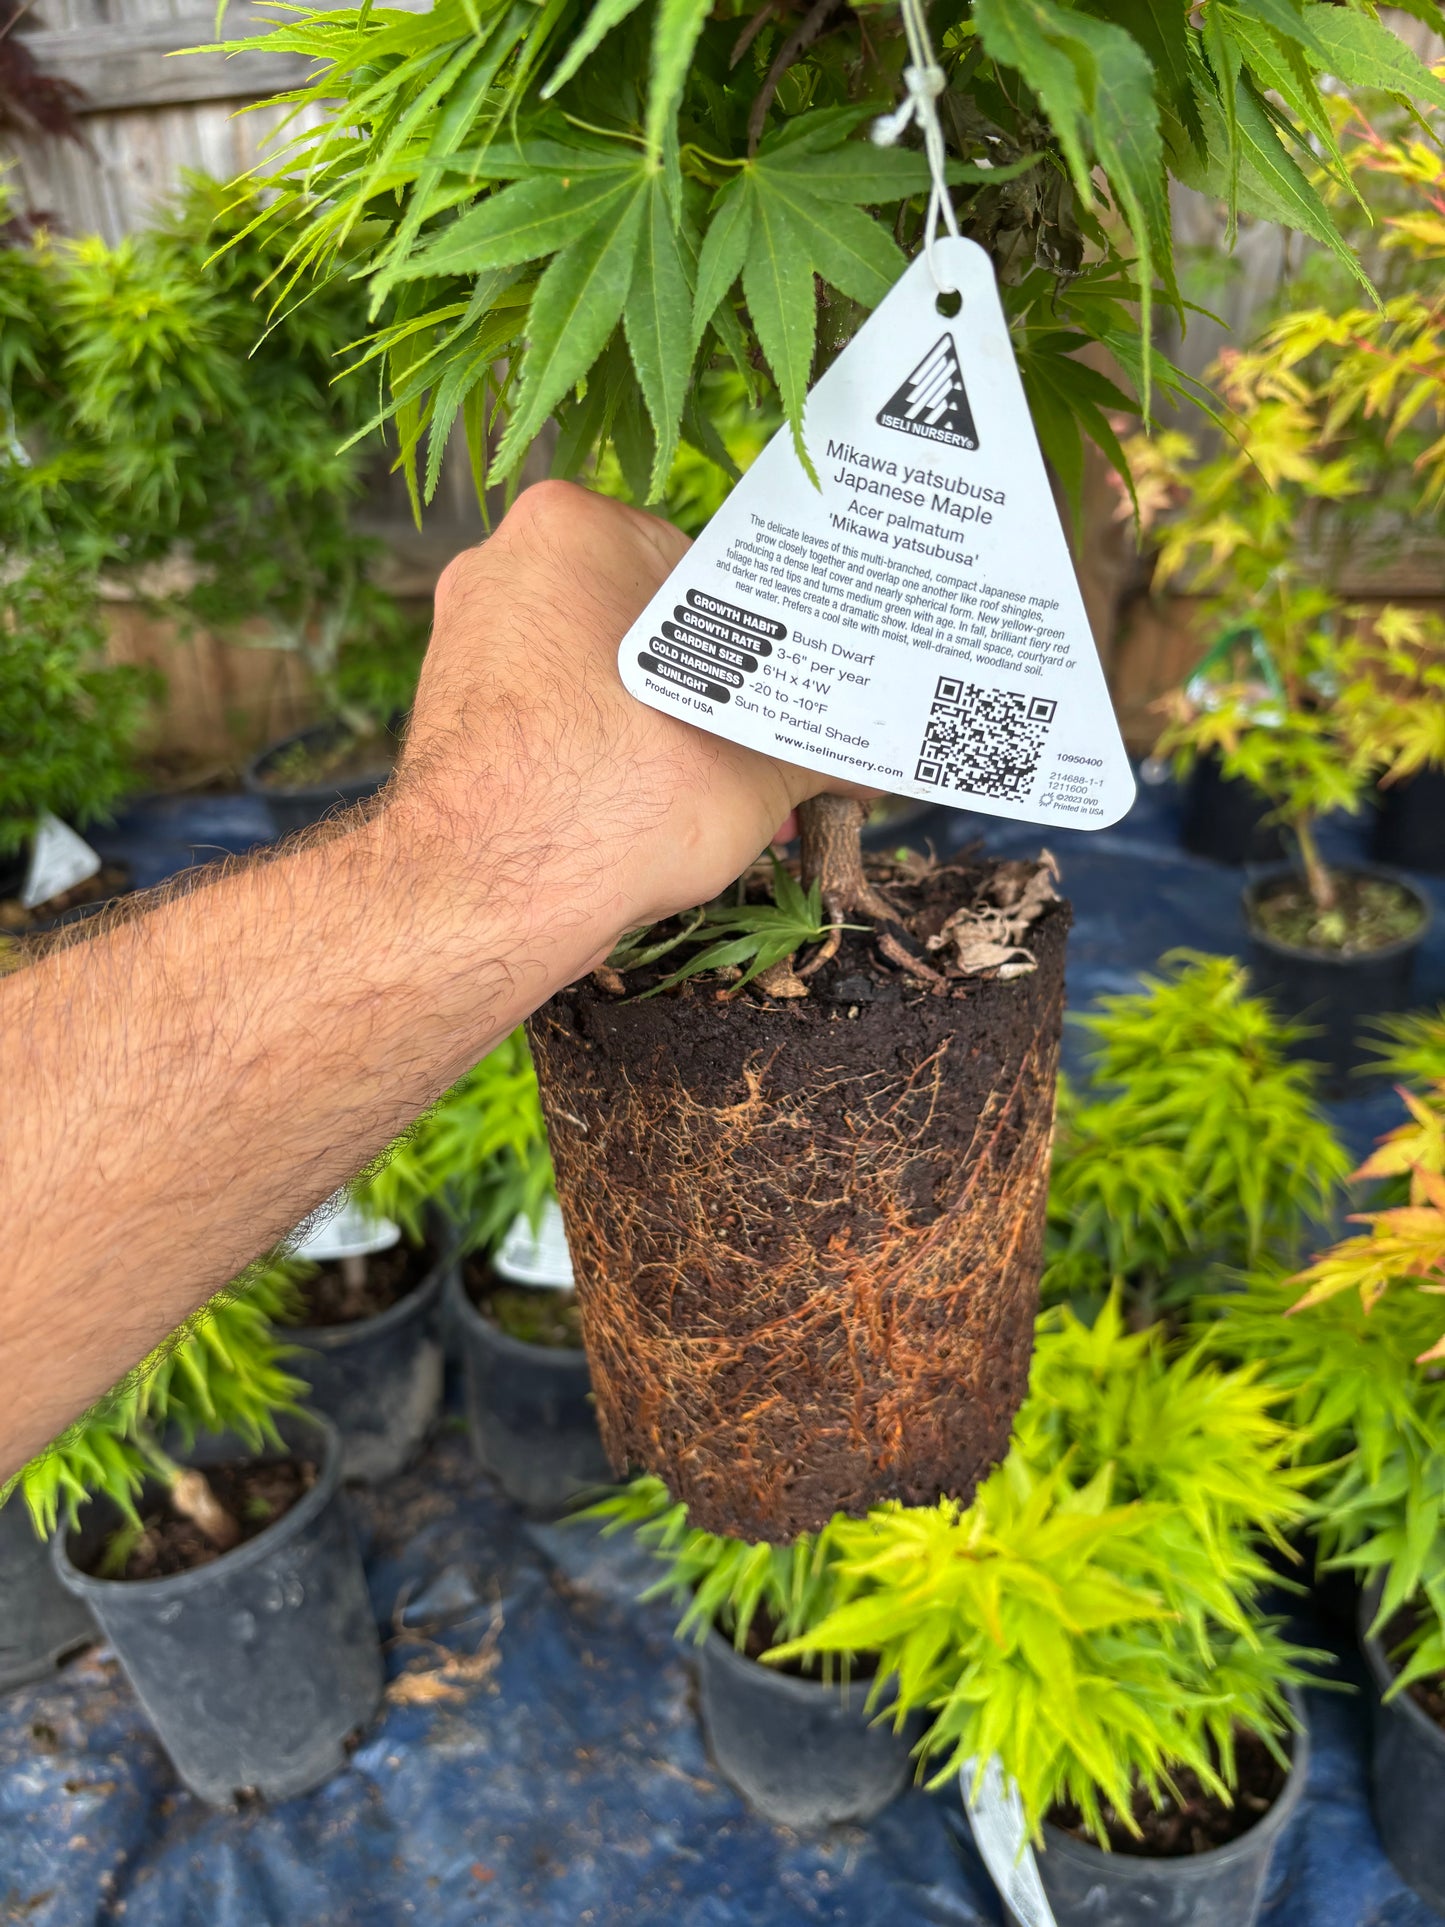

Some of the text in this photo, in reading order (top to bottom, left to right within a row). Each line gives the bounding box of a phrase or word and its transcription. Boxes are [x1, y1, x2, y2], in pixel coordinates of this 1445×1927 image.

[881, 414, 911, 431] ISELI
[826, 439, 1006, 506] Mikawa yatsubusa
[834, 467, 993, 525] Japanese Maple
[829, 513, 979, 567] 'Mikawa yatsubusa'
[847, 499, 965, 544] Acer palmatum
[751, 513, 1059, 610] The delicate leaves of this multi-branched, compact Japanese maple
[755, 532, 1044, 623] grow closely together and overlap one another like roof shingles,
[726, 547, 1071, 654] foliage has red tips and turns medium green with age. In fall, brilliant fiery red
[734, 538, 1065, 640] producing a dense leaf cover and nearly spherical form. New yellow-green
[683, 612, 761, 651] GROWTH RATE
[694, 594, 778, 635] GROWTH HABIT
[716, 559, 1077, 669] and darker red leaves create a dramatic show. Ideal in a small space, courtyard or
[735, 581, 1043, 676] near water. Prefers a cool site with moist, well-drained, woodland soil.
[652, 640, 740, 685] COLD HARDINESS
[674, 629, 743, 666] GARDEN SIZE
[777, 648, 871, 686] 3-6" per year
[792, 630, 875, 666] Bush Dwarf
[645, 678, 713, 716] Product of USA
[657, 663, 708, 692] SUNLIGHT
[749, 682, 772, 697] -20
[775, 689, 789, 703] to
[763, 664, 831, 695] 6'H x 4'W
[735, 695, 870, 748] Sun to Partial Shade
[775, 733, 903, 778] www.iselinursery.com
[1058, 753, 1103, 767] 10950400
[1049, 781, 1088, 794] 1211600
[1053, 802, 1104, 816] Printed in USA
